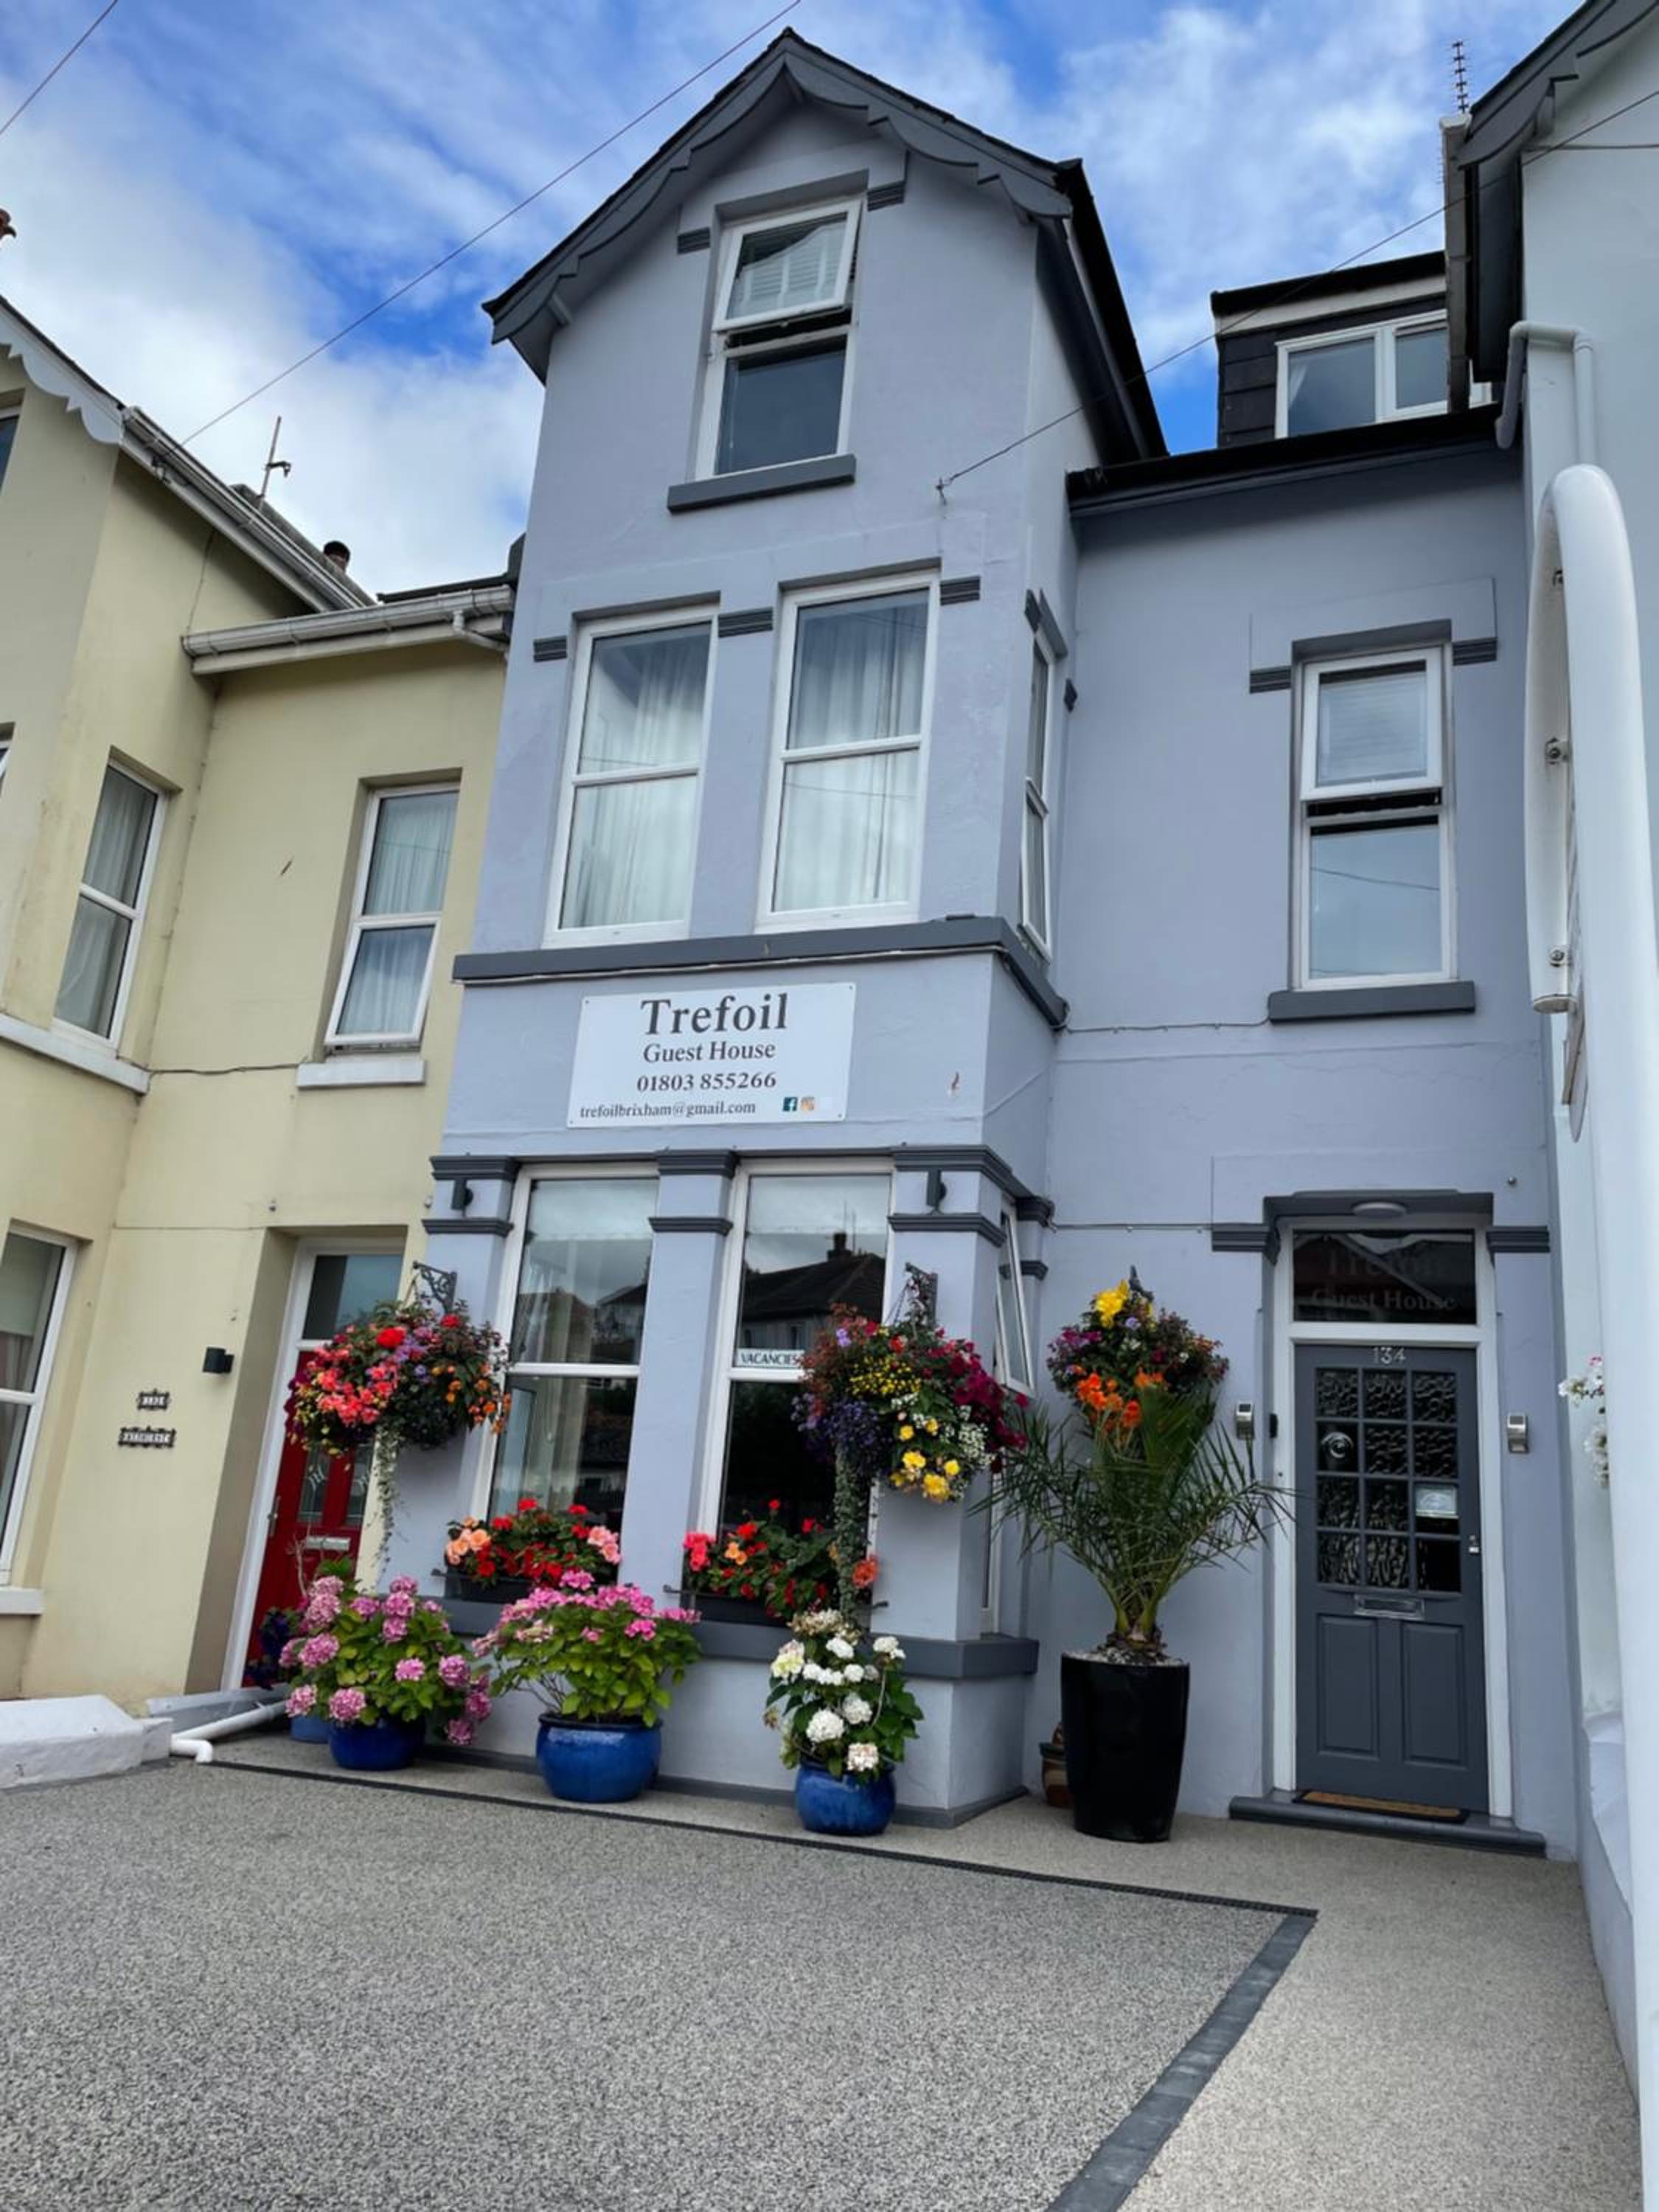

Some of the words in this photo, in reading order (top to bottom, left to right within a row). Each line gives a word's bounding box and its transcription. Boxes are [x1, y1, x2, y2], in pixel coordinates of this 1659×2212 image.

[641, 992, 787, 1034] Trefoil
[643, 1043, 703, 1063] Guest
[709, 1040, 776, 1060] House
[637, 1075, 694, 1092] 01803
[700, 1072, 776, 1090] 855266
[580, 1101, 756, 1119] trefoilbrixham@gmail.com
[1384, 1290, 1458, 1310] House
[741, 1352, 801, 1365] VACANCIES
[1371, 1346, 1406, 1364] 134
